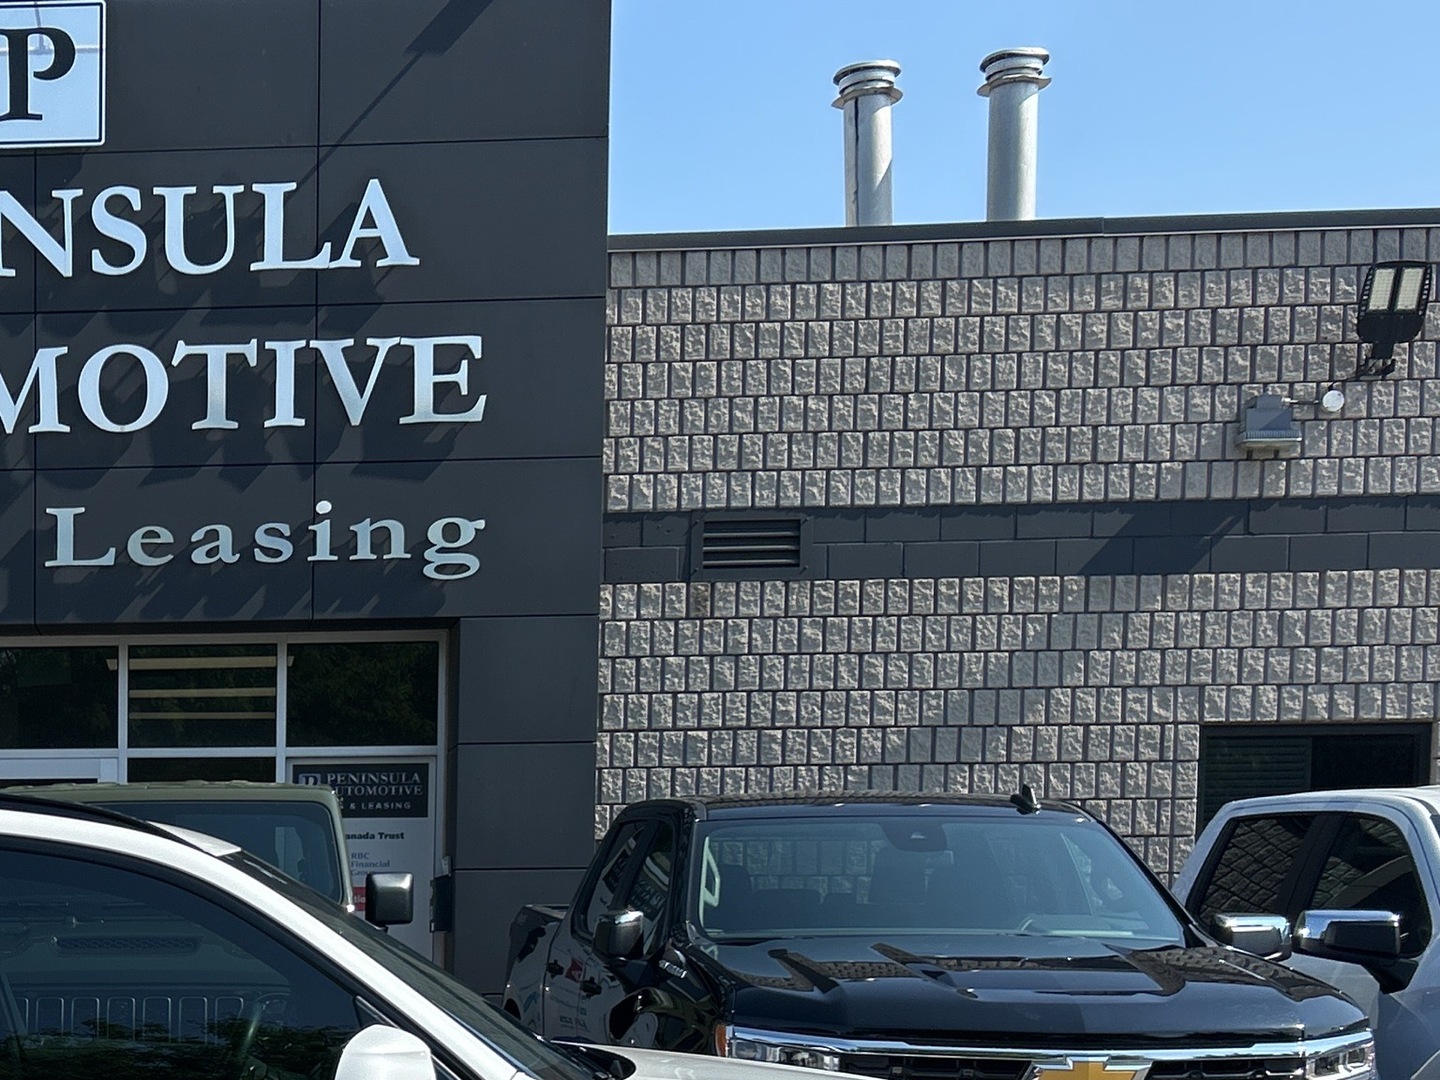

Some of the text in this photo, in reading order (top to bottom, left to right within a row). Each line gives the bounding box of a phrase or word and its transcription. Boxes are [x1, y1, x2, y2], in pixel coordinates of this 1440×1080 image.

[44, 500, 486, 580] Leasing
[327, 772, 421, 785] PENINSULA
[335, 785, 423, 797] UTOMOTIVE
[361, 801, 411, 810] LEASING
[345, 832, 405, 840] anada Trust
[351, 852, 370, 860] RBC
[351, 860, 391, 868] Financial
